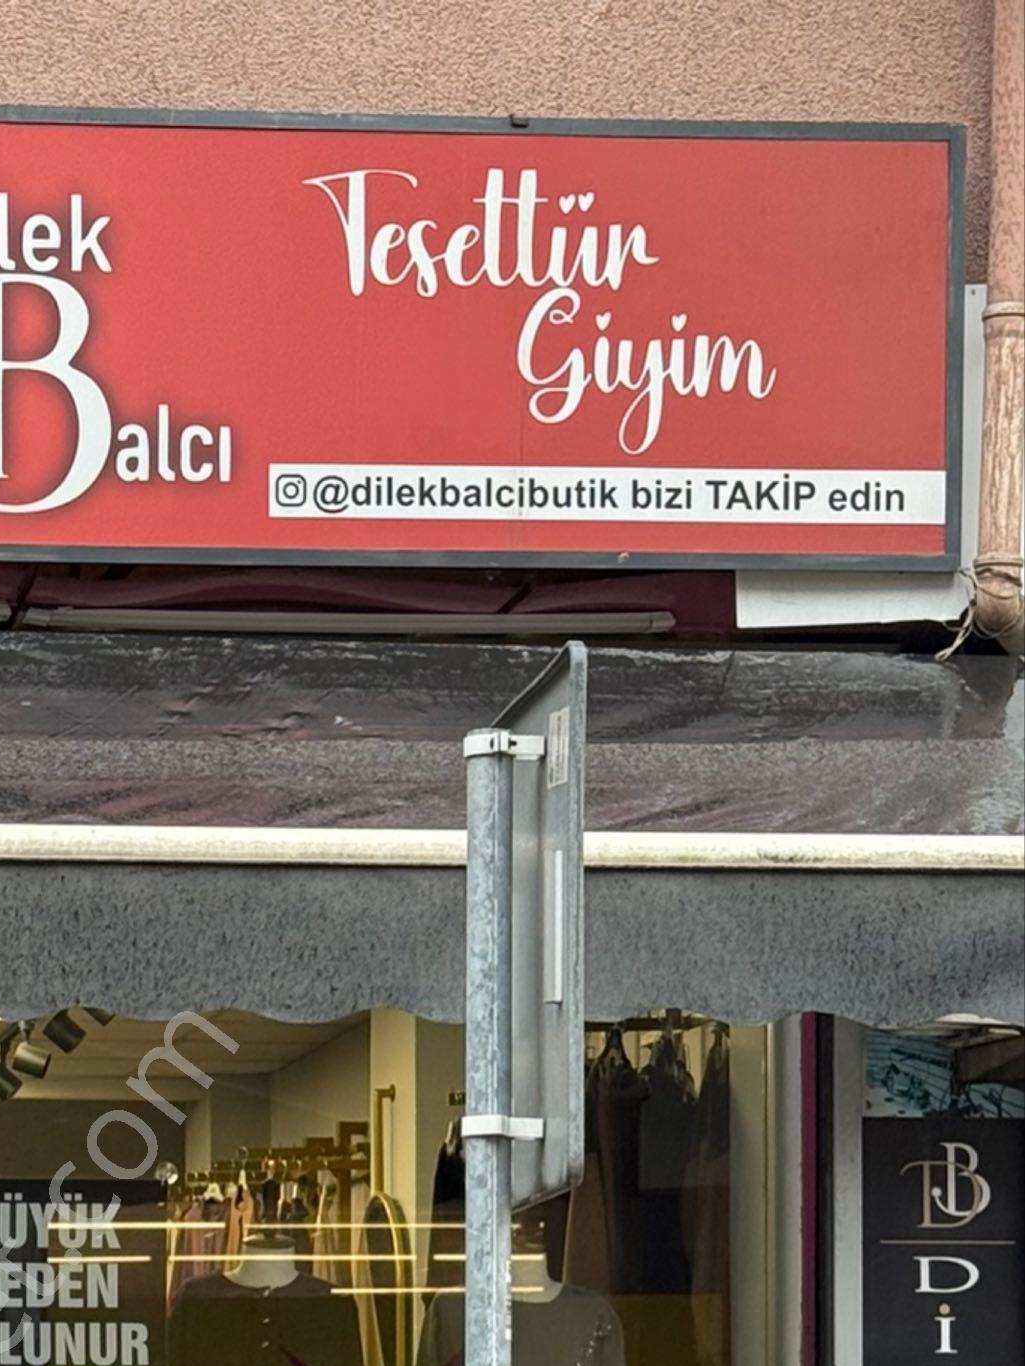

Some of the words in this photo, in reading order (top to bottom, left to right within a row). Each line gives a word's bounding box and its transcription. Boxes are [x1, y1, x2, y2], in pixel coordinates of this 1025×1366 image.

[302, 168, 660, 297] Tesettür
[517, 287, 776, 454] Giyim
[313, 476, 619, 514] @dilekbalcibutik
[632, 481, 693, 512] bizi
[705, 475, 817, 512] TAKİP
[828, 484, 906, 513] edin
